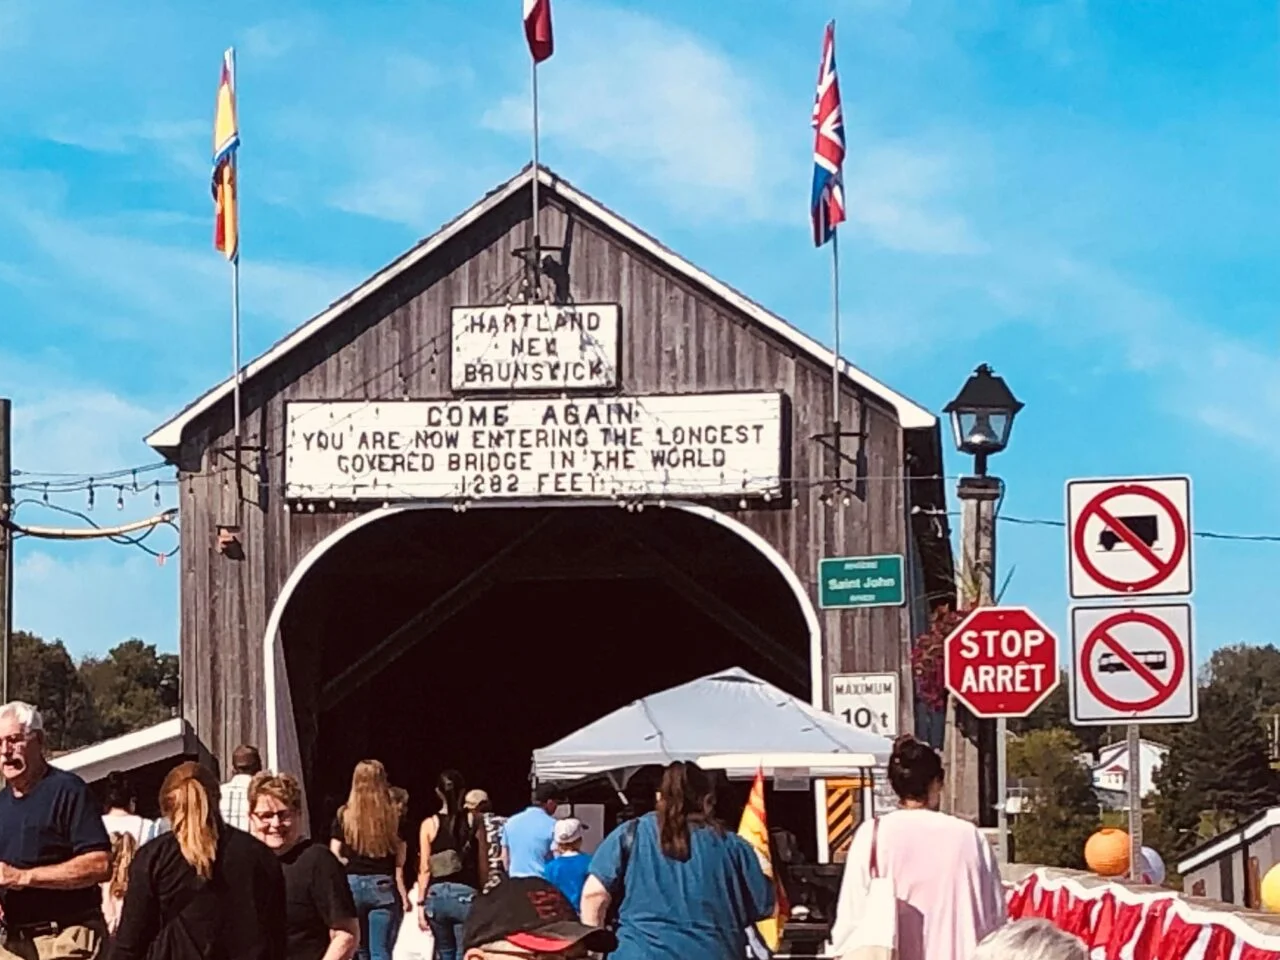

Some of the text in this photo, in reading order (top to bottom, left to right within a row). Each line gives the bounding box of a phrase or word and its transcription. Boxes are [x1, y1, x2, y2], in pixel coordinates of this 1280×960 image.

[470, 312, 601, 334] HARTLAND
[511, 337, 557, 357] NEW
[464, 360, 603, 383] BRUNSWICK
[427, 403, 634, 428] COME AGAIN
[302, 425, 765, 451] YOU ARE NOW ENTERING THE LONGEST
[337, 449, 726, 474] COVERED BRIDGE IN THE WORLD
[461, 473, 597, 494] 1282 FEET
[828, 577, 896, 590] Saint John
[959, 628, 1046, 659] STOP
[960, 659, 1047, 693] ARRÊT
[835, 683, 892, 695] MAXIMUM
[841, 707, 889, 729] 10 t
